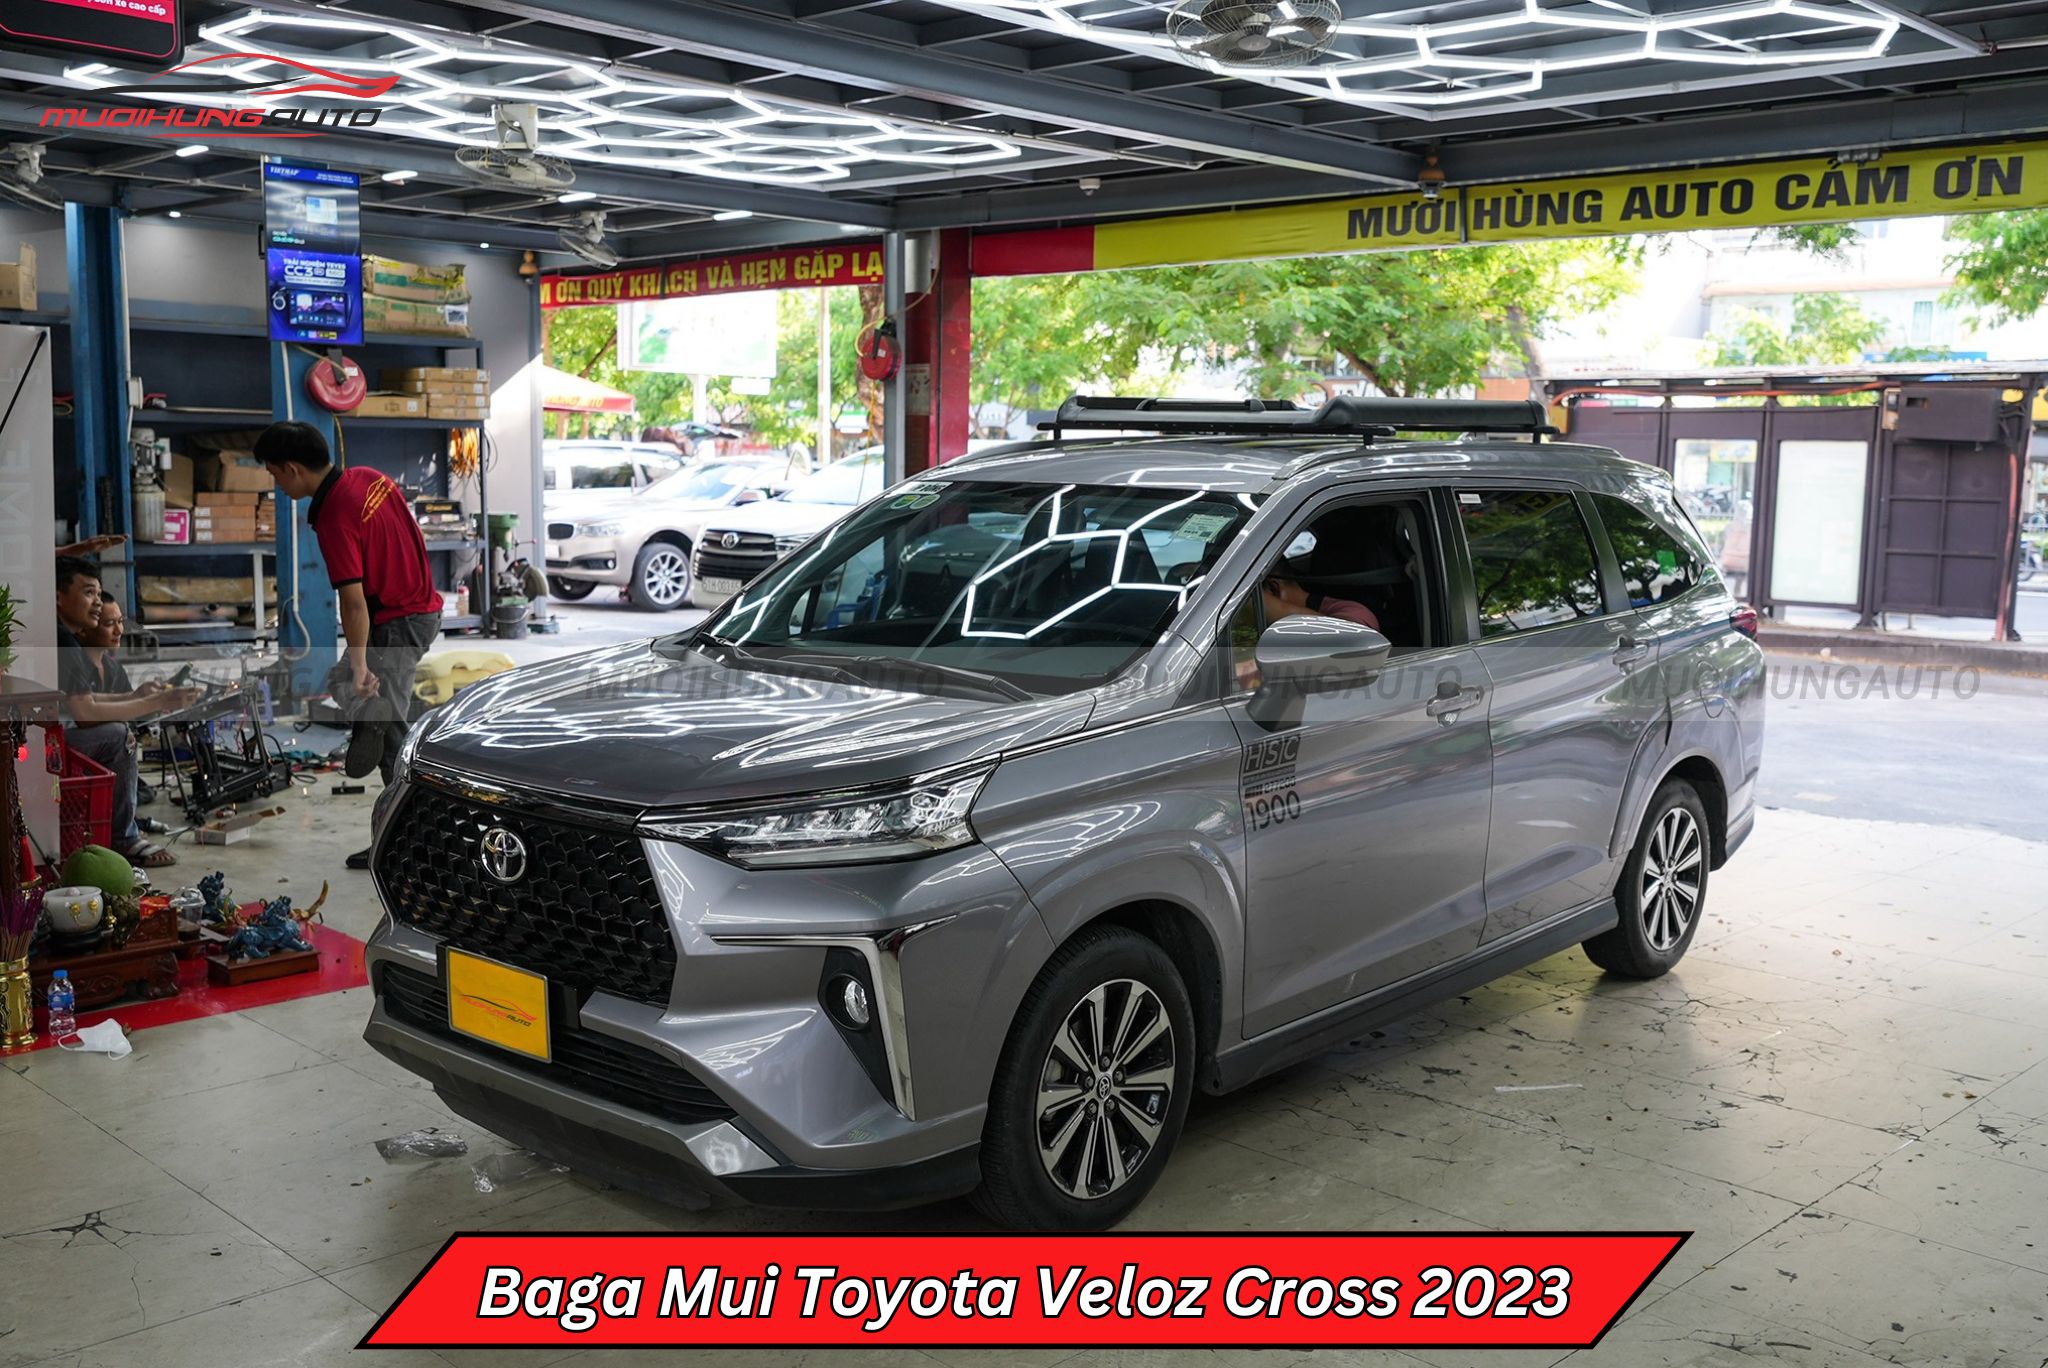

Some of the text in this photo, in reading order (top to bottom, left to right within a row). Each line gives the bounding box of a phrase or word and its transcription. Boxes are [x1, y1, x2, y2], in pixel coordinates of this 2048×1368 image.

[128, 2, 147, 11] cao
[148, 4, 166, 16] cấp
[1473, 188, 1603, 230] HÙNG
[1620, 178, 1754, 221] AUTO
[1933, 155, 2024, 199] ƠN
[556, 279, 581, 303] ƠN
[587, 273, 624, 302] QUÝ
[706, 260, 735, 289] VÀ
[741, 257, 787, 288] HẸN
[794, 249, 844, 284] GẶP
[852, 251, 884, 282] LẠ
[1245, 790, 1301, 832] 1900
